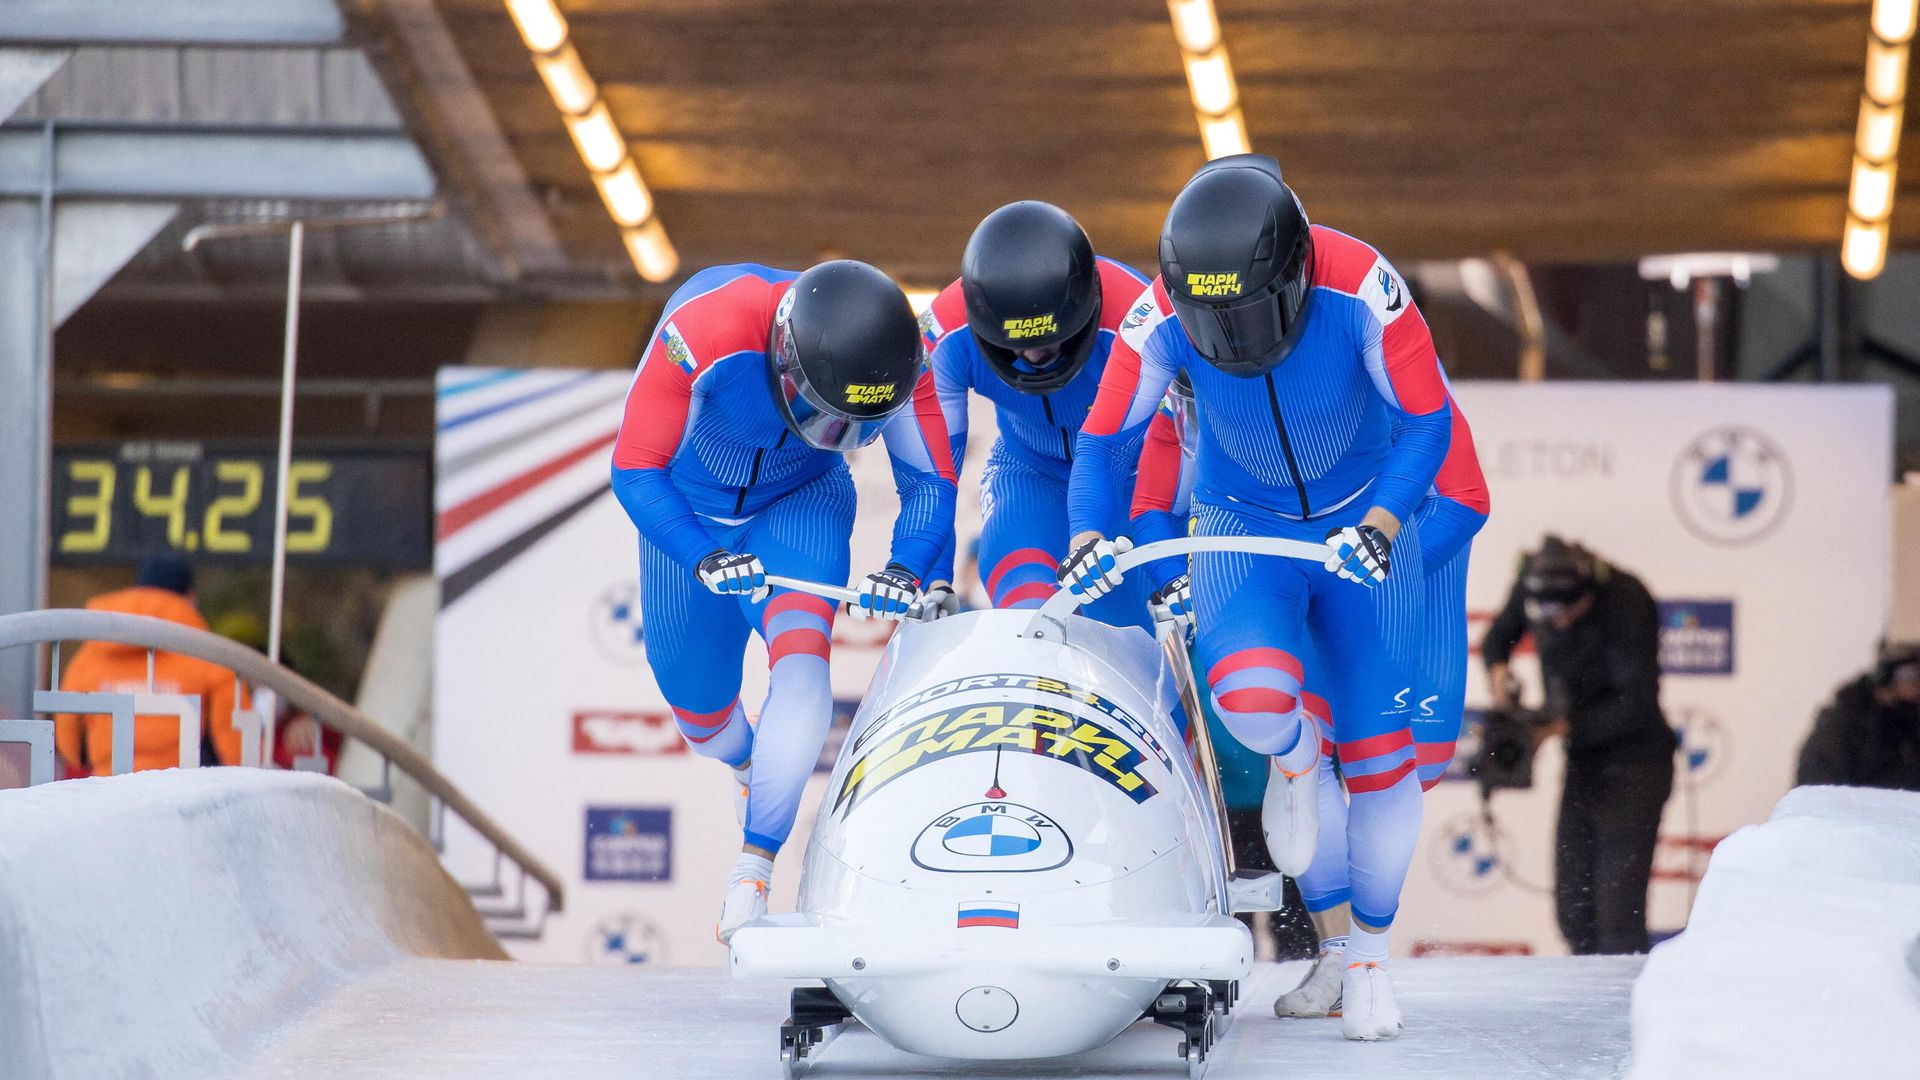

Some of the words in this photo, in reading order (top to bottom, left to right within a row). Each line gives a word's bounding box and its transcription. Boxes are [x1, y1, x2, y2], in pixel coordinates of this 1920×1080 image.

[1187, 272, 1238, 285] ПАРИ
[1191, 283, 1242, 296] МАТЧ
[1003, 314, 1053, 329] ПАРИ
[1008, 322, 1057, 338] МАТЧ
[845, 384, 895, 395] ПАРИ
[846, 393, 895, 404] МАТЧ
[1477, 440, 1617, 478] LETON
[60, 460, 333, 553] 34.25
[843, 705, 1132, 797] ПАРИ
[854, 726, 1144, 804] МАТЧ
[935, 805, 1054, 829] BMW
